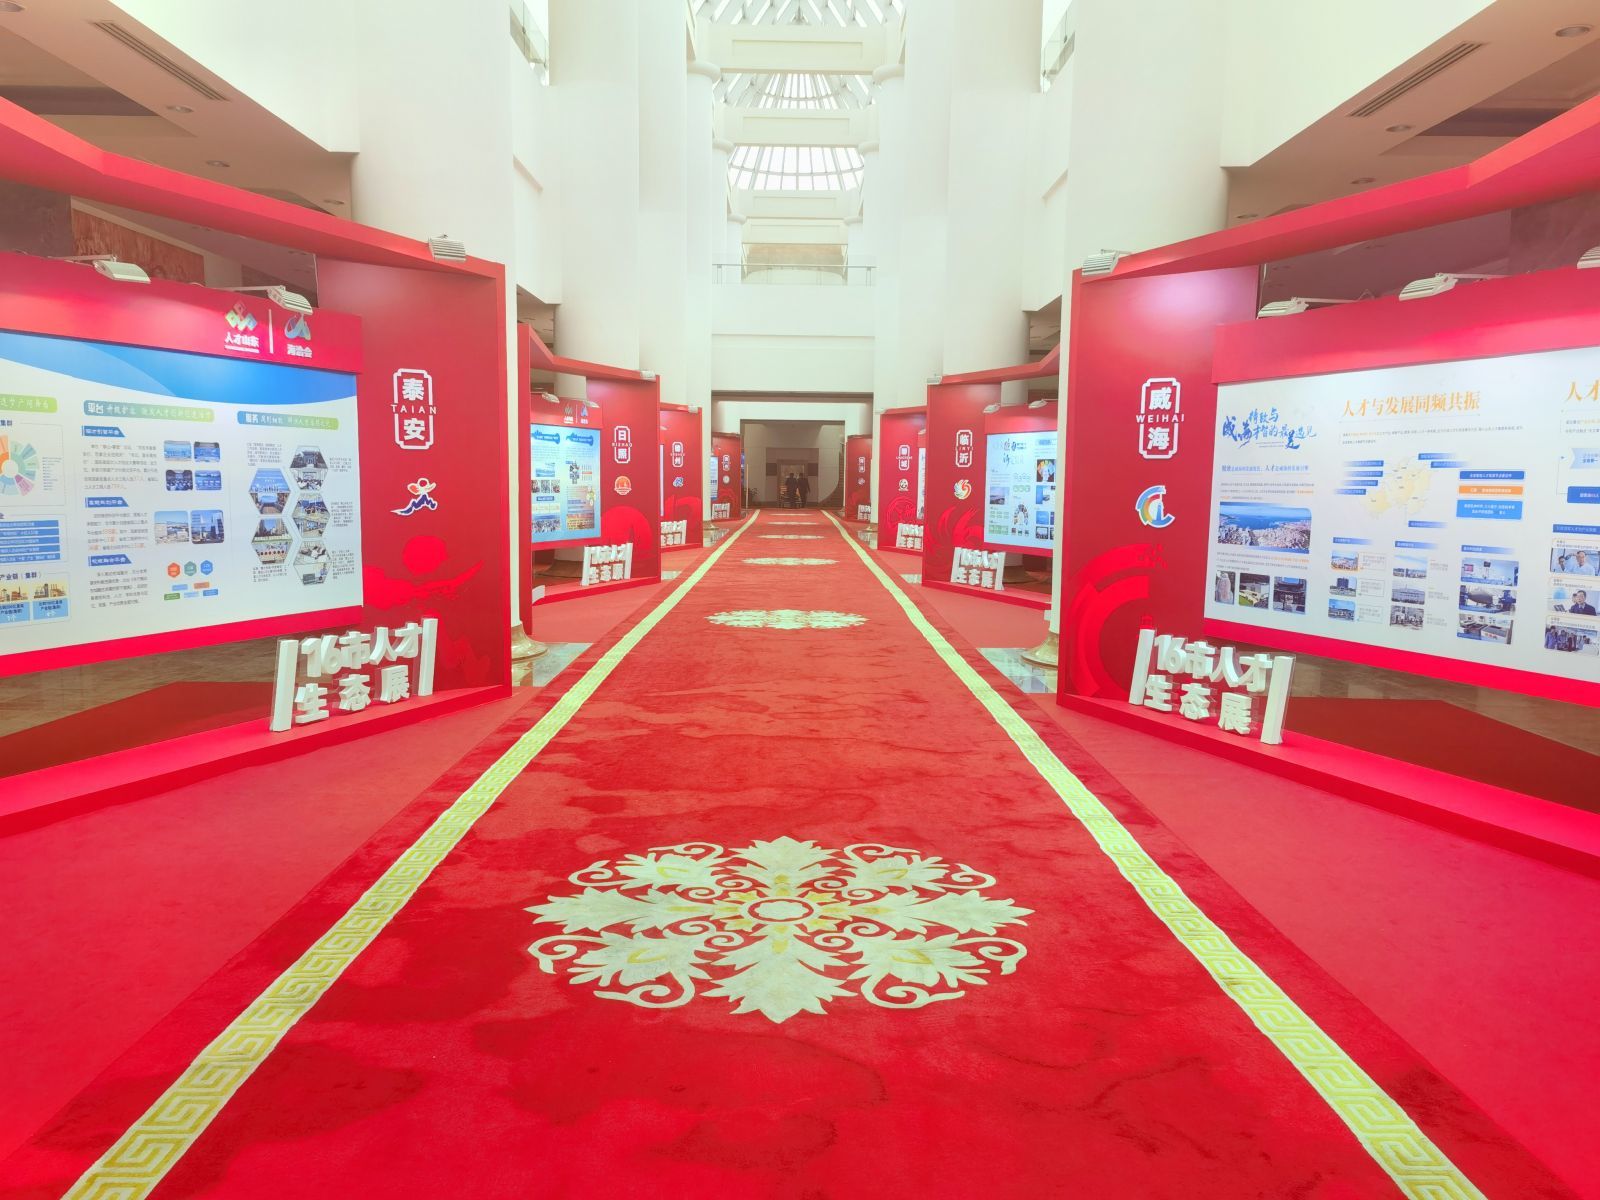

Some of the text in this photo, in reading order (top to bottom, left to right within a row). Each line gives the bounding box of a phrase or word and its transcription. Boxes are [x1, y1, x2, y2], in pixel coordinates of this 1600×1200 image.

[224, 331, 260, 348] 人才山东
[390, 403, 437, 415] TAIAN
[1135, 413, 1185, 424] WEIHAI
[1341, 390, 1482, 418] 人才与发展同频共振
[300, 622, 423, 678] 16市人才
[1153, 634, 1273, 693] 16市人才
[294, 664, 410, 724] 生态展
[1143, 674, 1252, 735] 生态展
